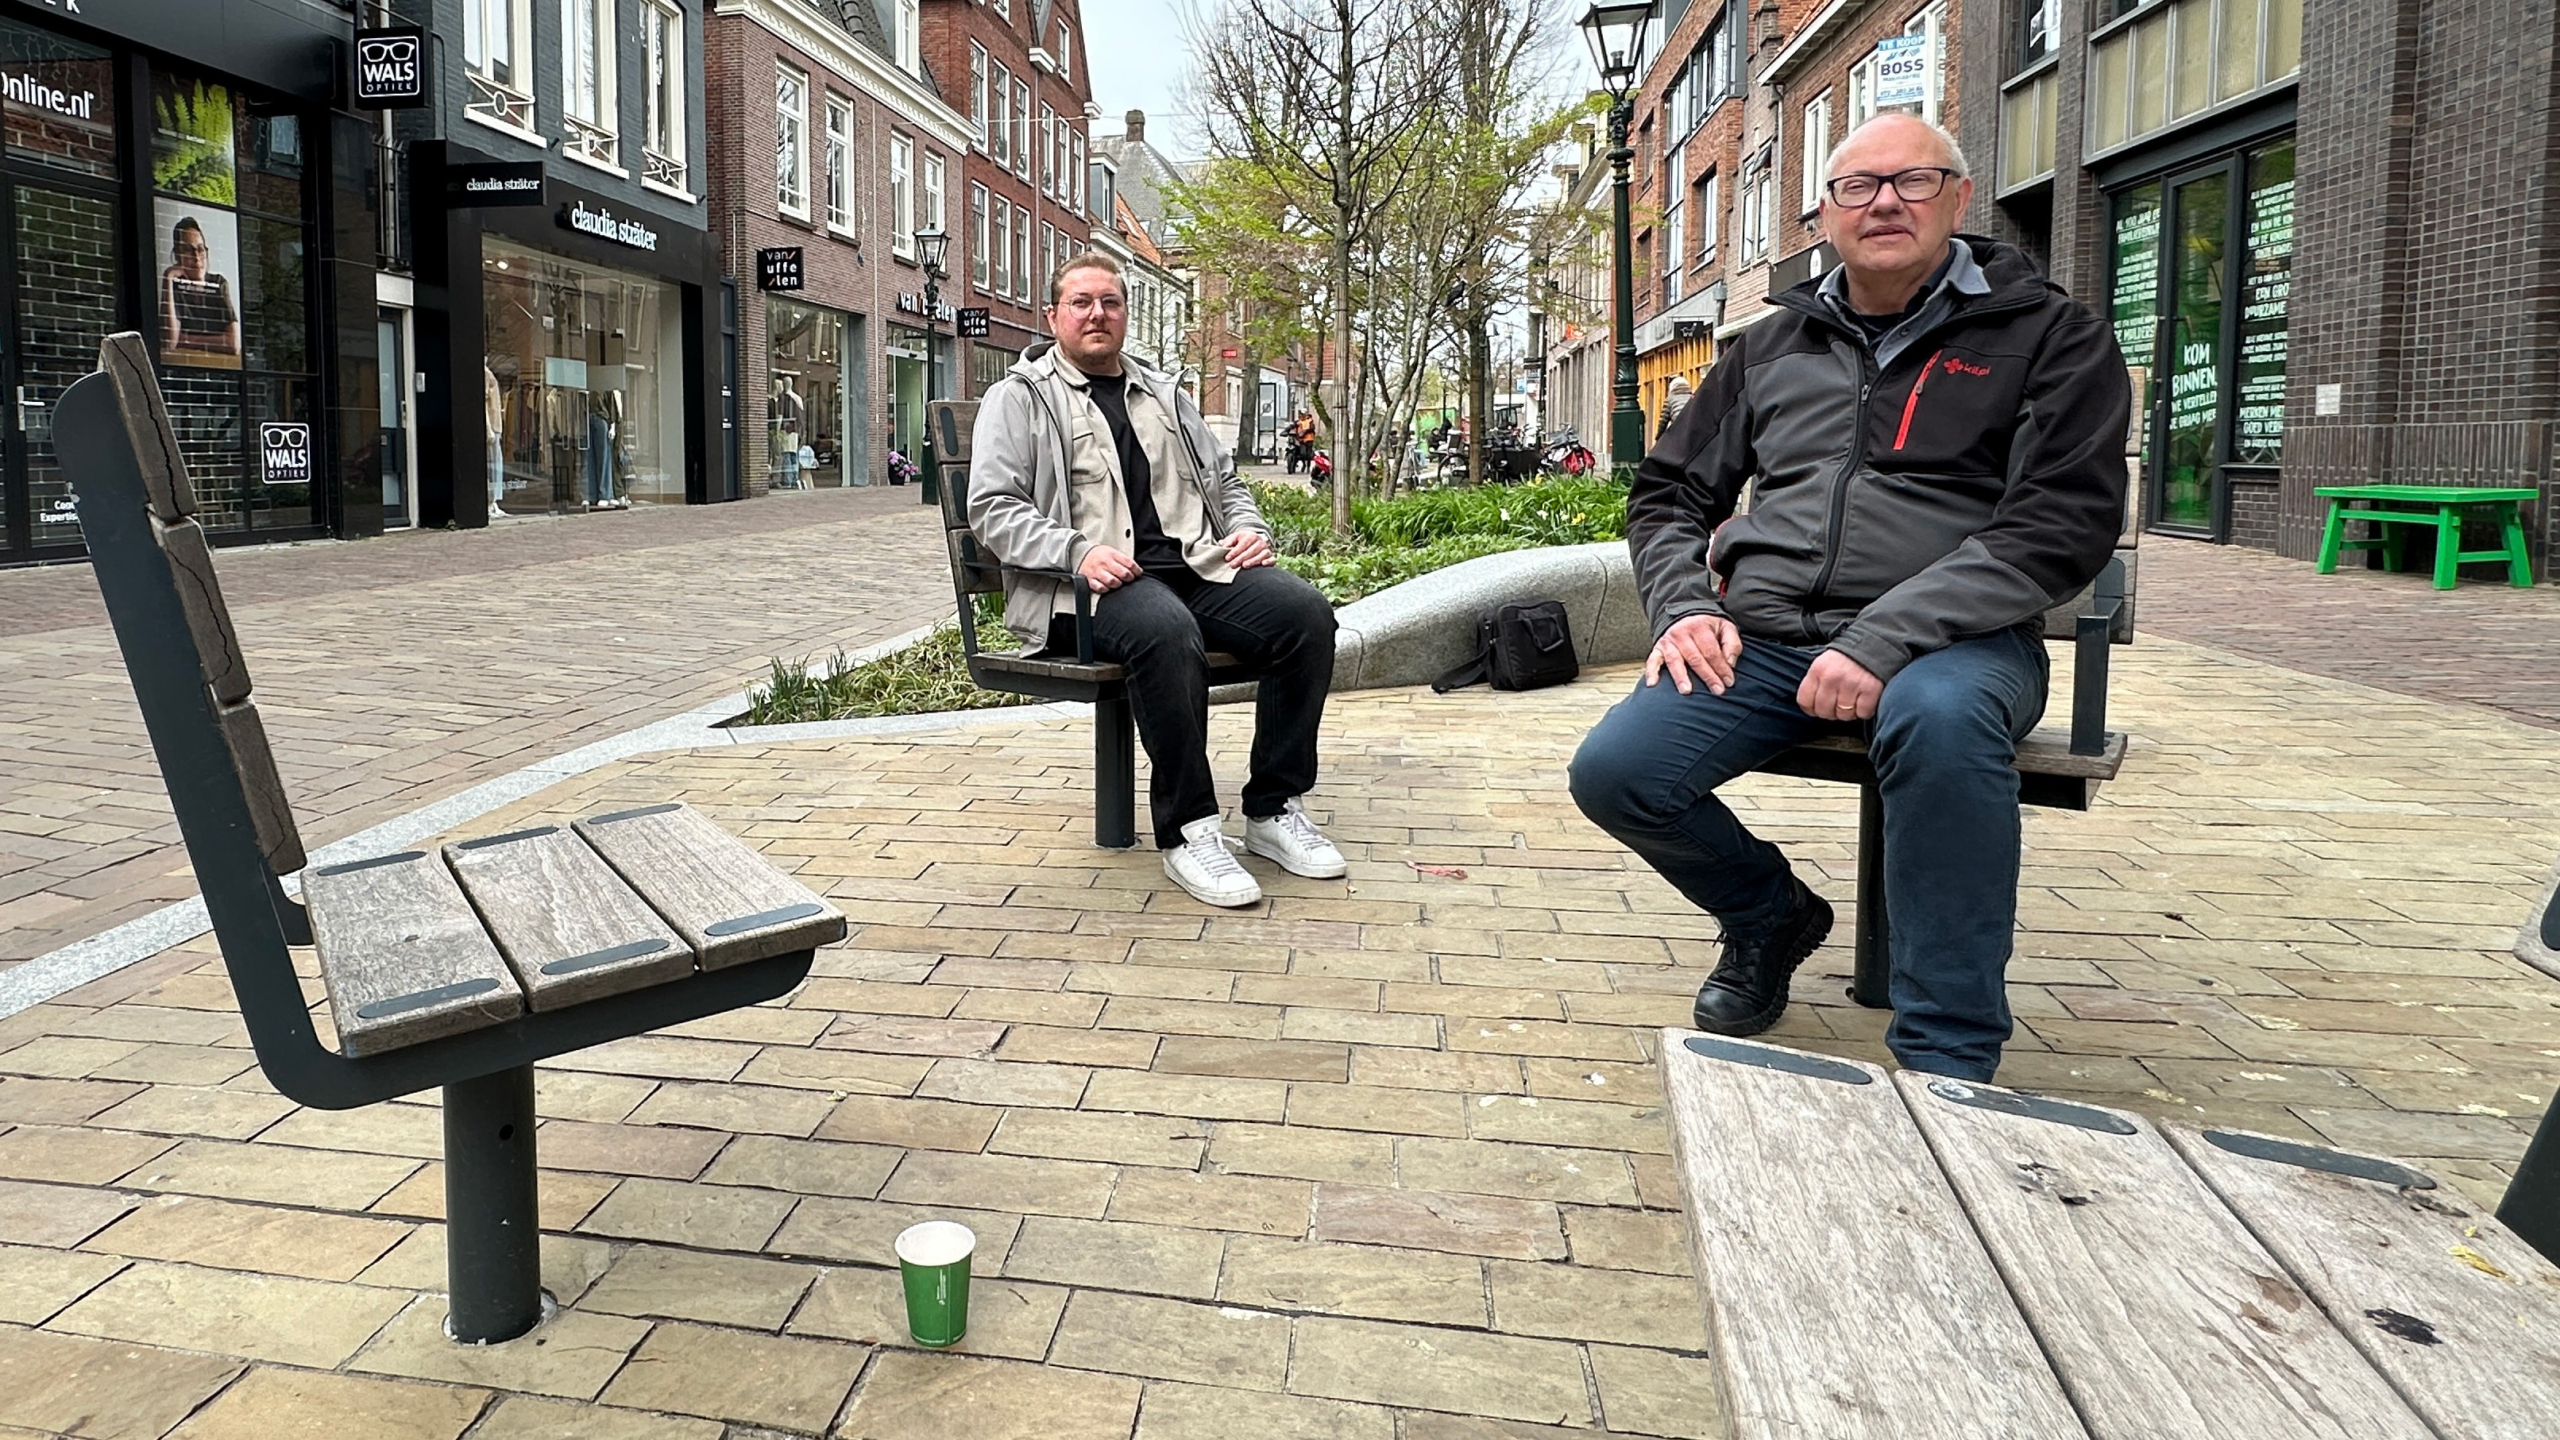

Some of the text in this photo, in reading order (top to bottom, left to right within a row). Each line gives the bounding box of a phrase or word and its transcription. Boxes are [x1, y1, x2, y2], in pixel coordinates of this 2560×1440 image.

[1898, 36, 1925, 47] KOOP
[363, 62, 415, 82] WALS
[1881, 58, 1924, 76] BOSS
[366, 82, 412, 92] OPTIEK
[467, 178, 540, 191] claudia sträter
[571, 200, 657, 251] claudia sträter
[766, 261, 797, 273] uffe
[922, 298, 958, 323] uelen
[2184, 343, 2210, 366] KOM
[2172, 365, 2218, 397] BINNEN.
[265, 449, 306, 468] WALS
[268, 470, 306, 479] OPTIEK
